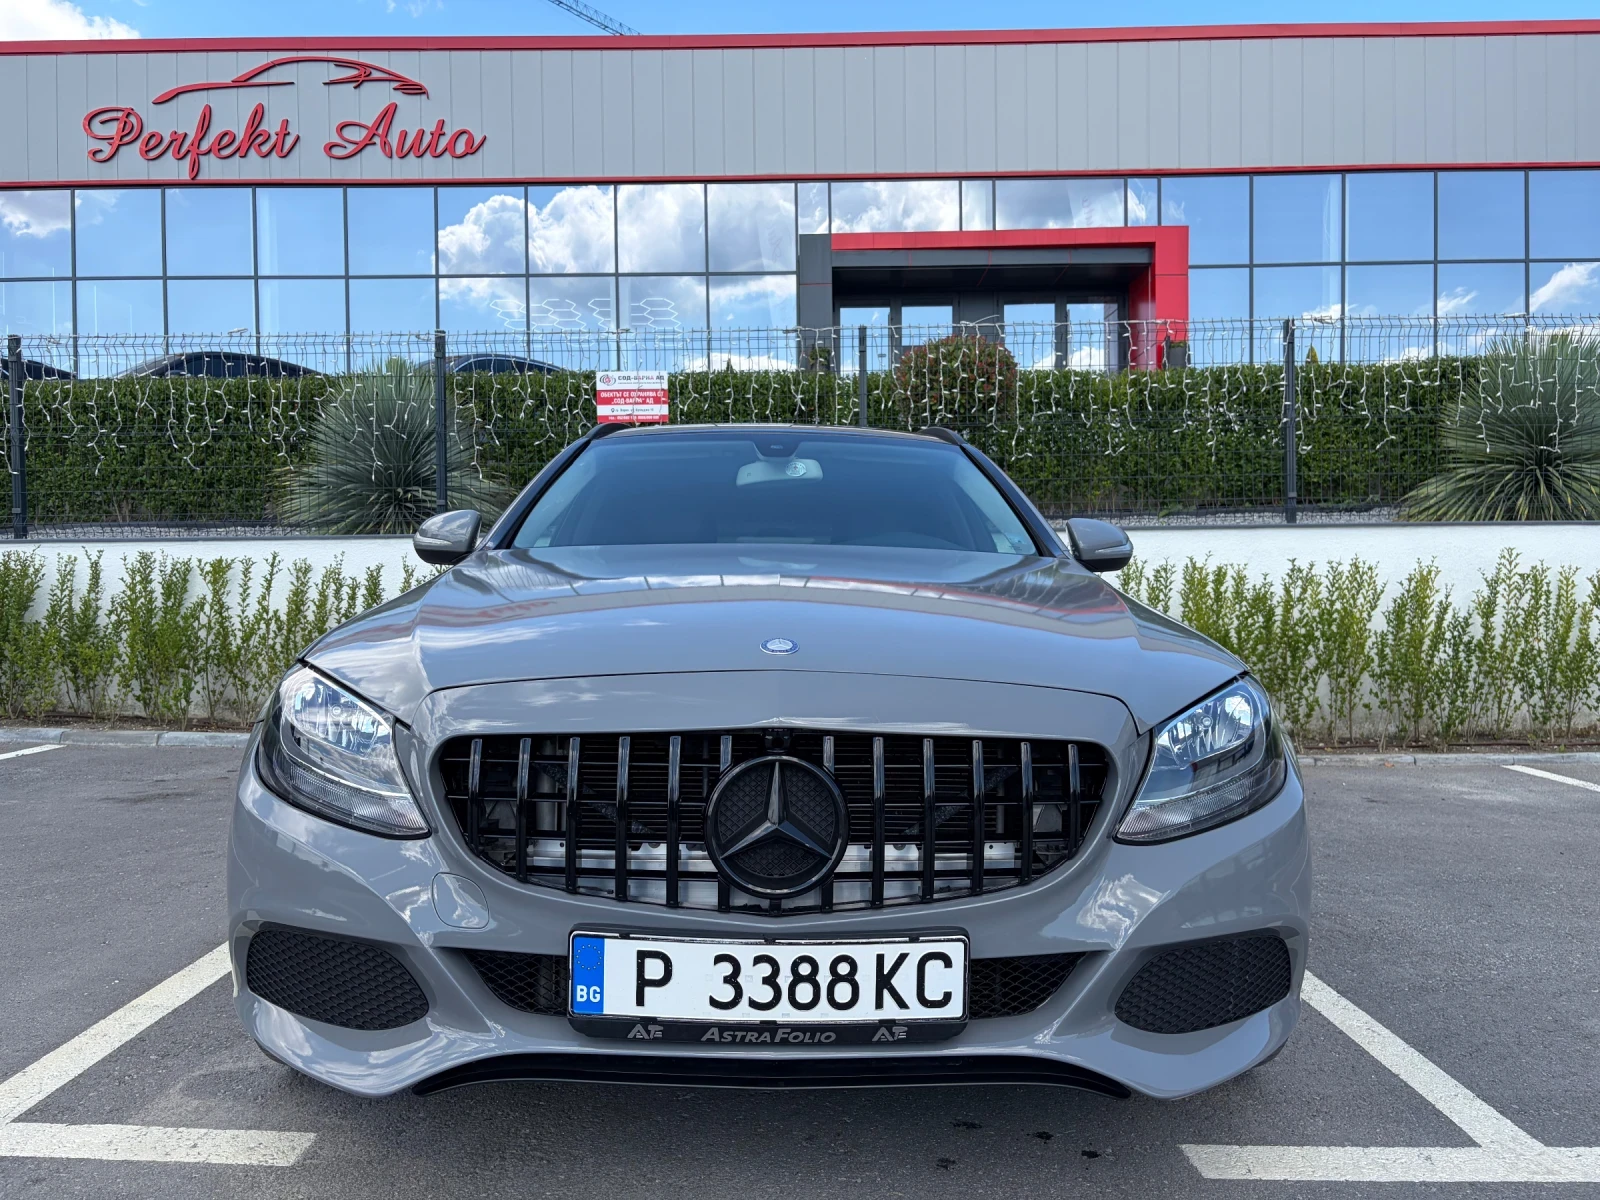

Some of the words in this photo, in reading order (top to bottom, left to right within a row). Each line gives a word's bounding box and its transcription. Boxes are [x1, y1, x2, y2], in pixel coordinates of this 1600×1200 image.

[82, 102, 300, 180] Perfekt
[323, 102, 487, 159] Auto
[576, 985, 601, 1003] BG
[635, 949, 674, 1008] P
